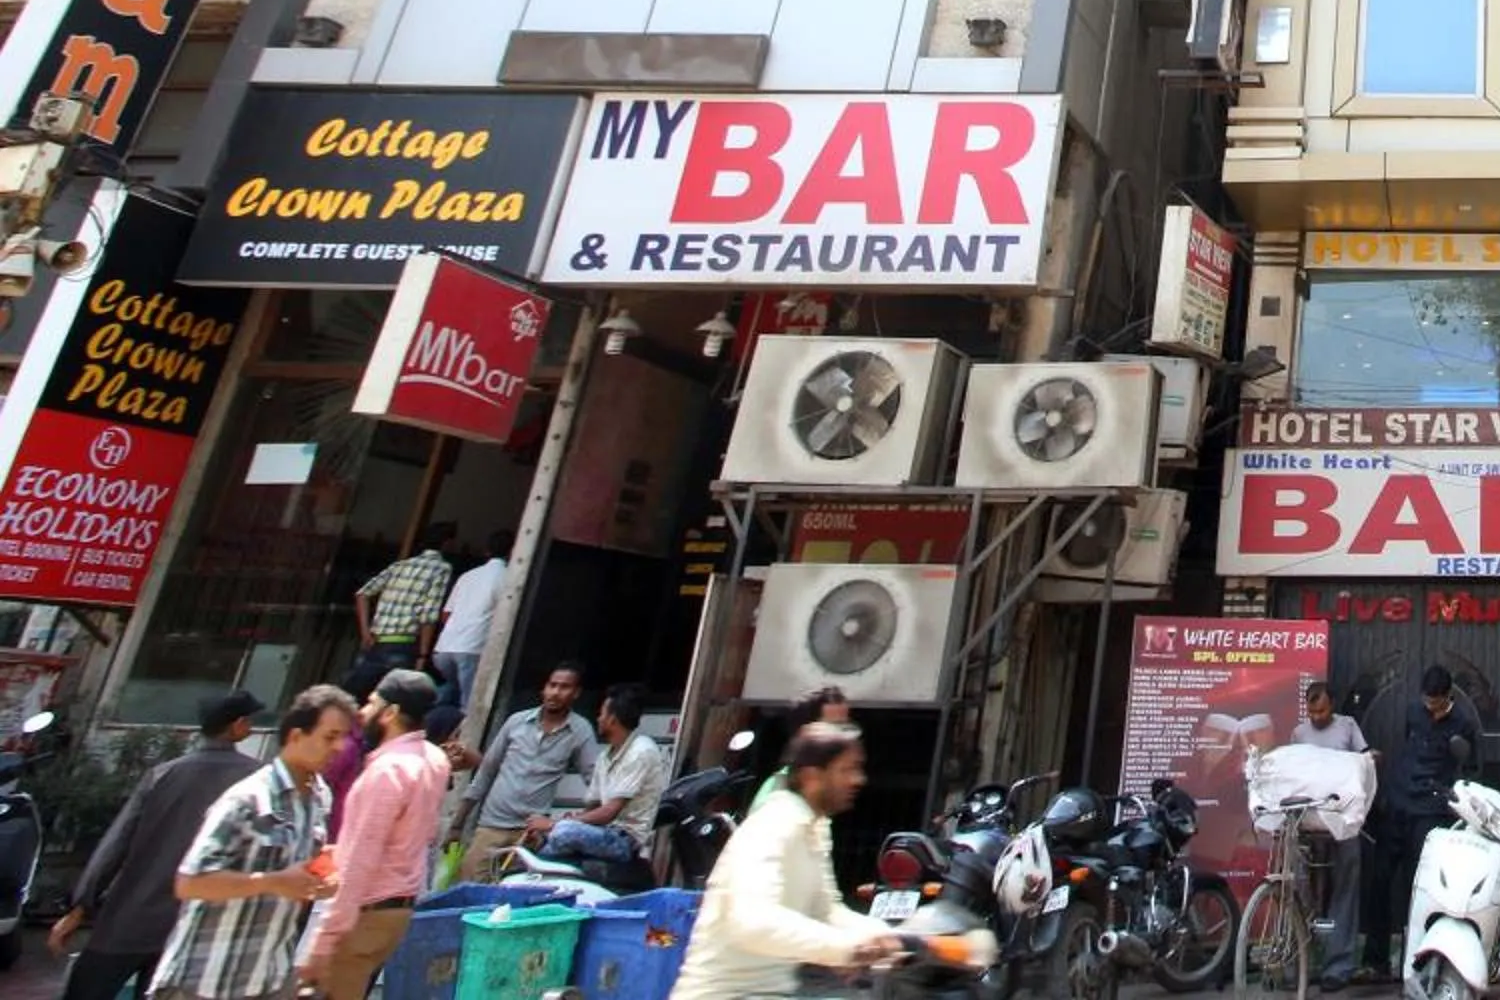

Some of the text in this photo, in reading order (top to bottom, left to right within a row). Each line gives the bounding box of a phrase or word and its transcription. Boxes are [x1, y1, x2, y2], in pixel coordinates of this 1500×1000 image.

[305, 117, 491, 170] Cottage
[589, 99, 1038, 226] MY BAR
[225, 176, 524, 223] Crown Plaza
[239, 241, 348, 261] COMPLETE
[352, 243, 422, 261] GUEST
[569, 233, 1020, 274] & RESTAURANT
[1313, 235, 1465, 265] HOTEL
[89, 279, 235, 350] Cottage
[86, 323, 207, 384] Crown
[66, 363, 189, 424] Plaza
[1251, 411, 1373, 445] HOTEL
[1385, 412, 1480, 445] STAR
[1243, 453, 1393, 471] White Heart
[14, 465, 170, 514] ECONOMY
[0, 501, 159, 550] HOLIDAYS
[803, 512, 857, 530] 650ML
[1302, 591, 1413, 623] Live
[1184, 628, 1327, 649] WHITE HEART BAR
[1225, 651, 1275, 663] OFFERS
